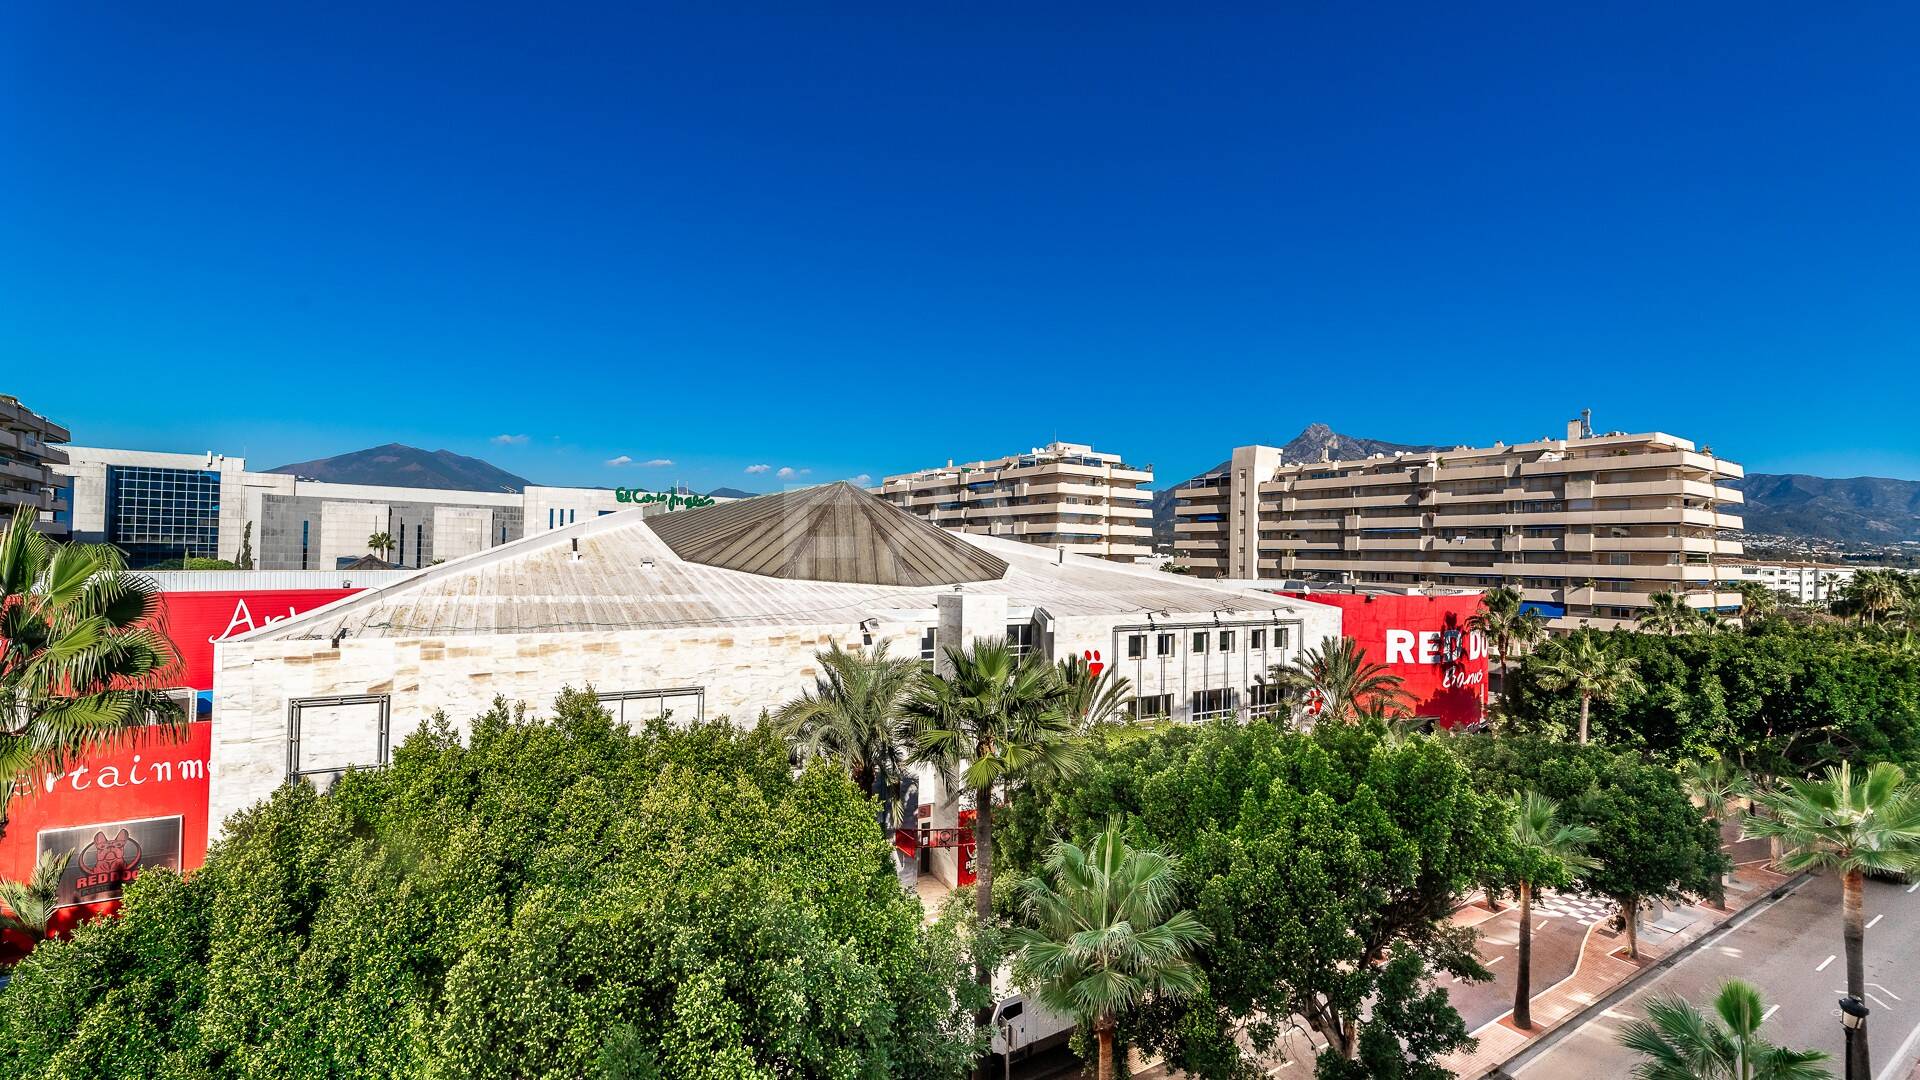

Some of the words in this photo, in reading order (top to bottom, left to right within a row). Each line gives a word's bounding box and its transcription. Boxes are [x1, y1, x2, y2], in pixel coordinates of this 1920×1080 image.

[616, 487, 631, 502] El
[633, 489, 667, 503] Corte
[668, 487, 715, 511] Inglés
[1386, 629, 1462, 664] RED
[77, 873, 108, 888] RED
